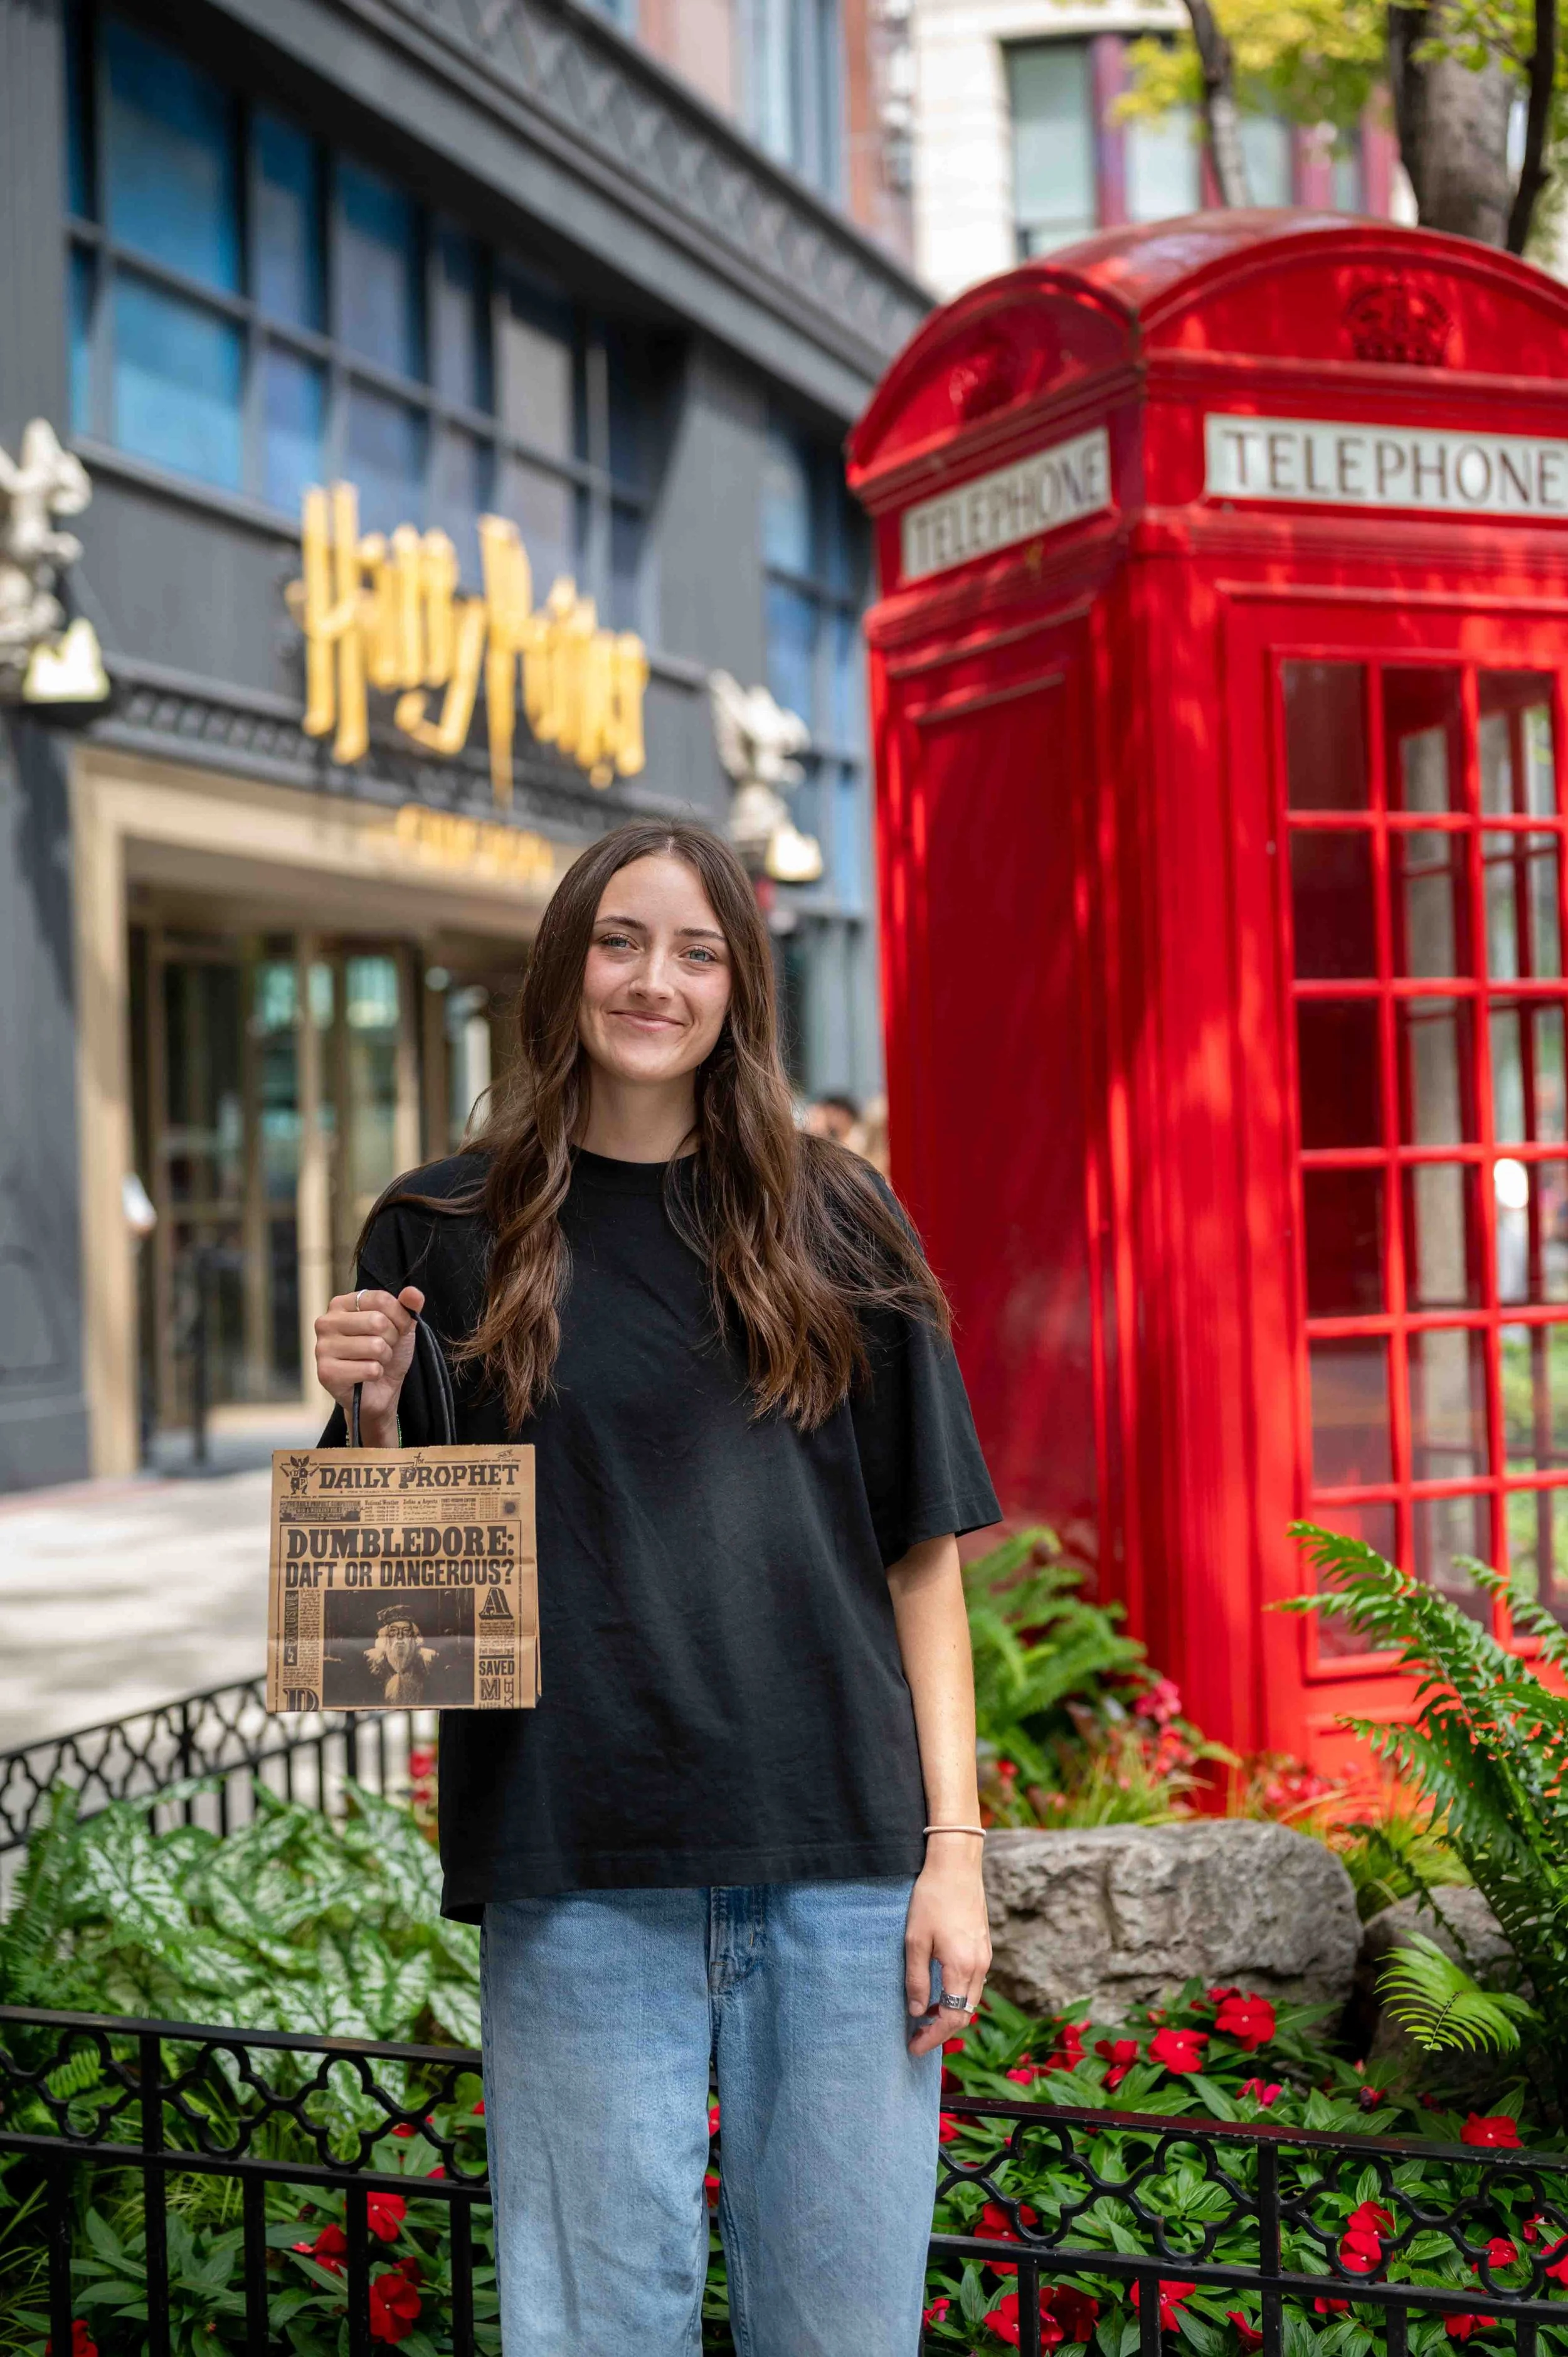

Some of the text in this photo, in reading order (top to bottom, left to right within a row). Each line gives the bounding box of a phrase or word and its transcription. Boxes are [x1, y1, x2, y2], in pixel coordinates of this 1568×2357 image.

[1222, 429, 1567, 509] TELEPHONE
[911, 442, 1108, 568] TELEPHONE
[319, 1464, 519, 1489] DAILY PROPHET
[287, 1526, 514, 1559] DUMBLEDORE:
[285, 1558, 515, 1588] DAFT OR DANGEROUS?
[285, 1594, 298, 1647] EXCLUSIVE
[479, 1660, 515, 1676] SAVED
